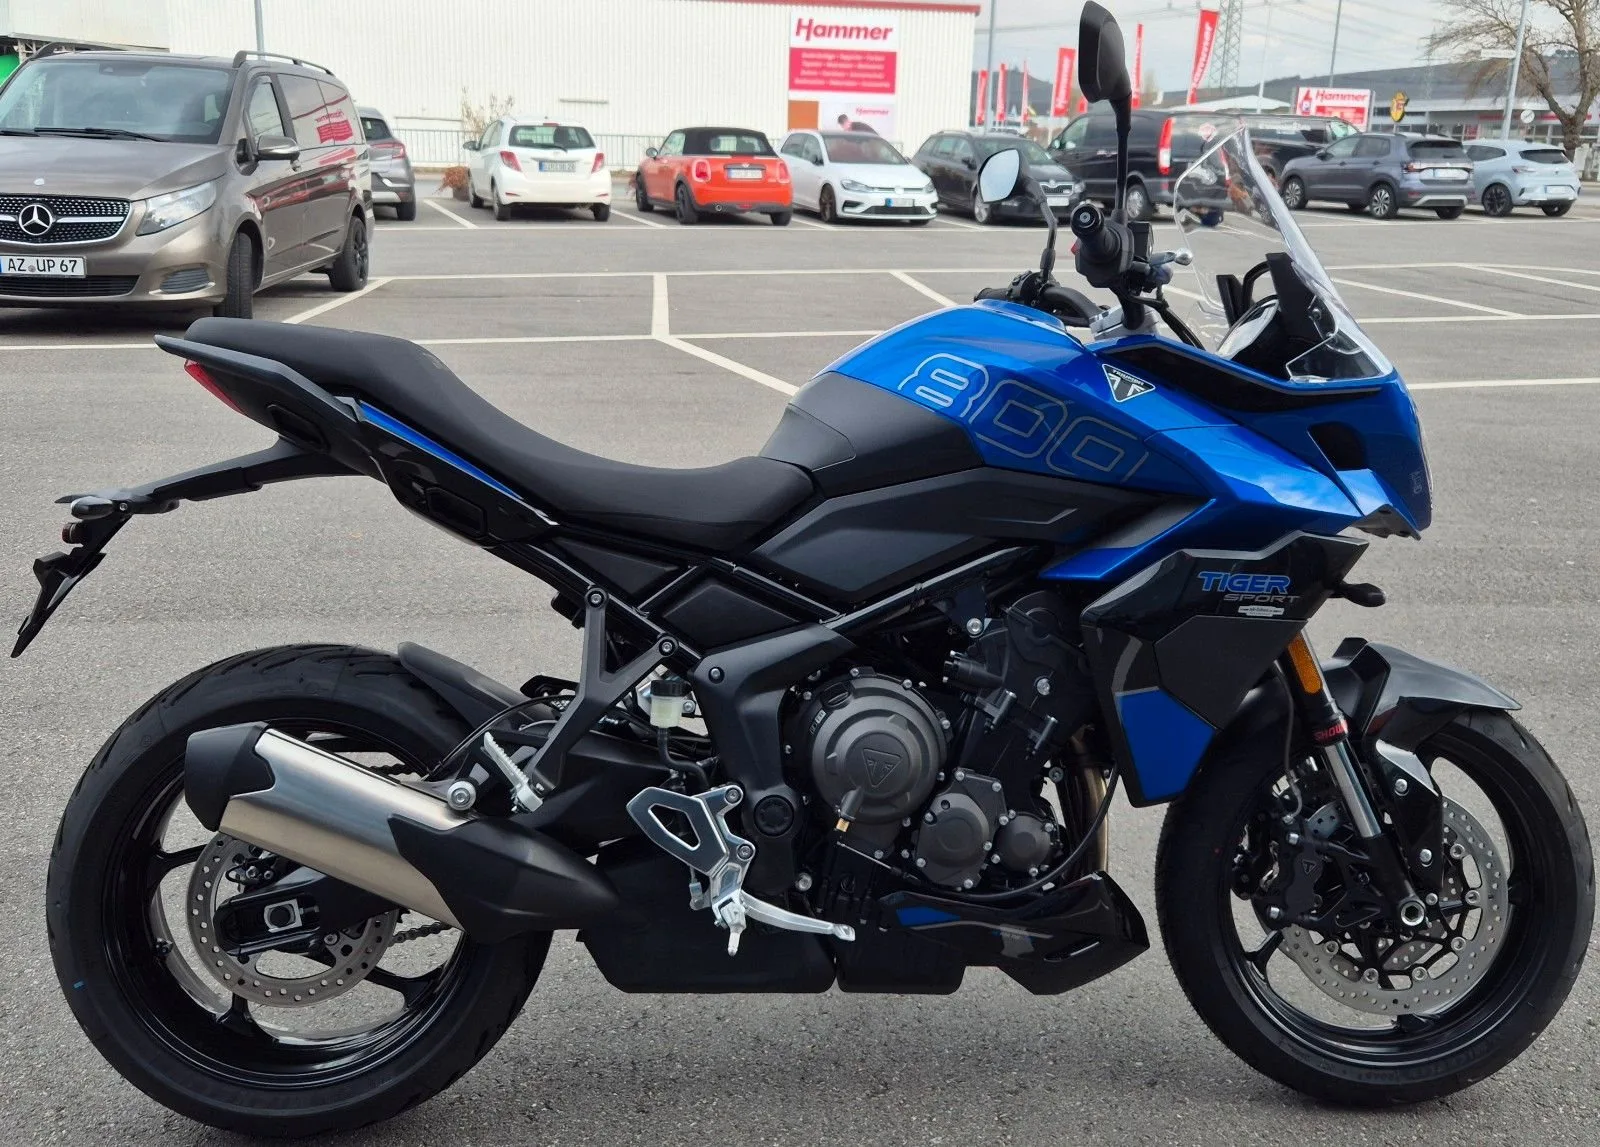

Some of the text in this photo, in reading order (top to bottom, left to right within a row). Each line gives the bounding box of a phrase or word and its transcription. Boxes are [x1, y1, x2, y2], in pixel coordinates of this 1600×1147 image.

[795, 18, 893, 41] Hammer
[8, 258, 77, 273] AZ UP 67
[897, 352, 1149, 484] 800
[1198, 571, 1290, 594] TIGER
[1223, 593, 1300, 603] SPORT
